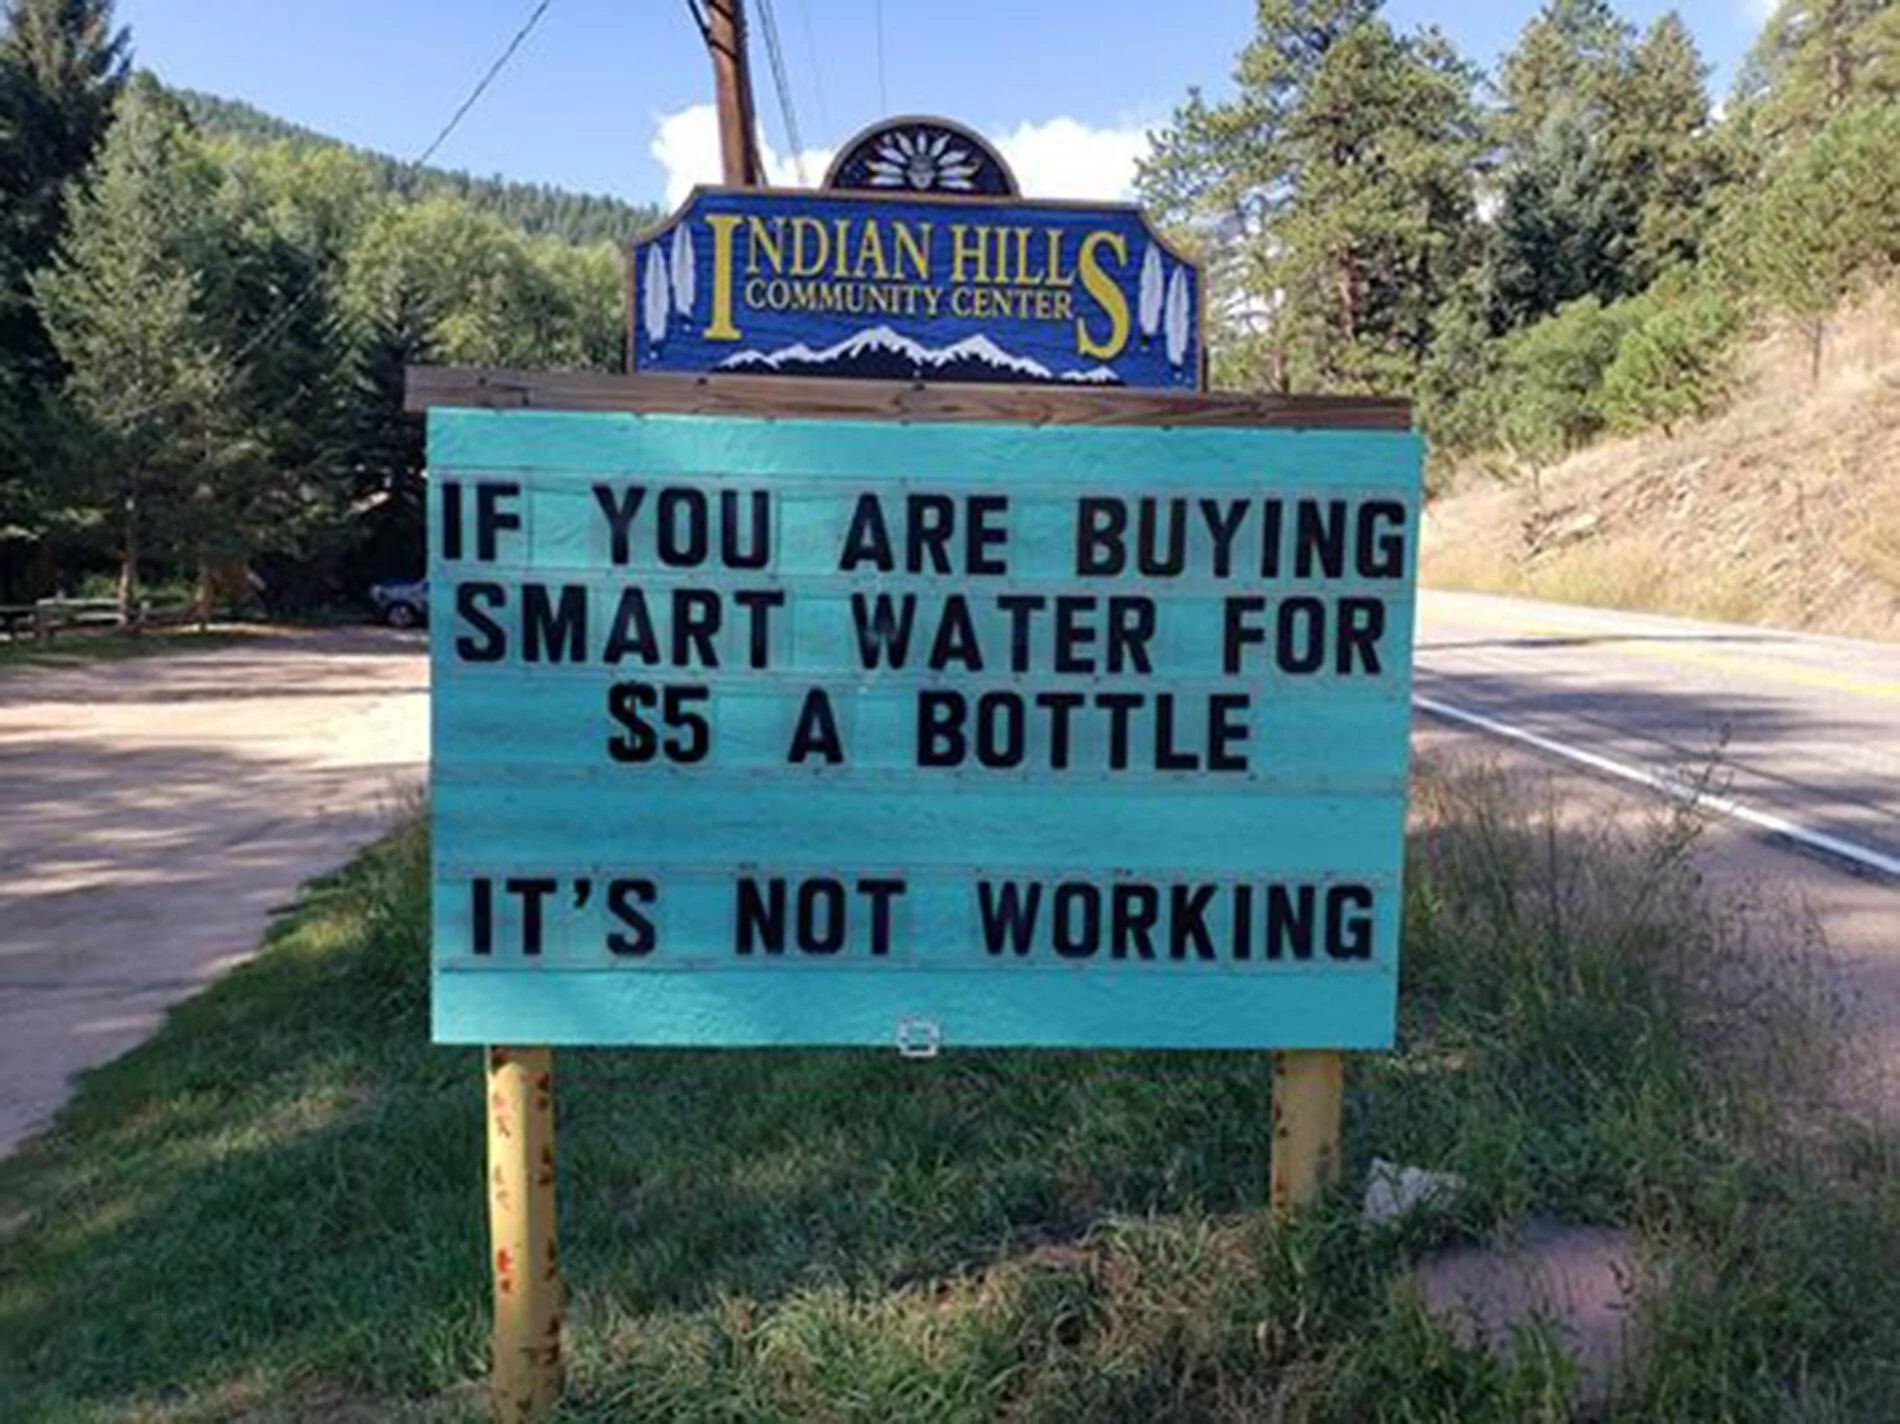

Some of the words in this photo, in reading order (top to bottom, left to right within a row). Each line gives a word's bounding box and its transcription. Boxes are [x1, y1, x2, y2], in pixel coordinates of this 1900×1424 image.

[704, 214, 931, 341] INDIAN
[950, 224, 1129, 360] HILLS
[745, 279, 943, 316] COMMUNITY
[955, 286, 1073, 321] CENTER
[441, 482, 521, 561] IF
[592, 483, 770, 570] YOU
[839, 493, 1009, 576] ARE
[1076, 496, 1406, 579] BUYING
[455, 582, 785, 669] SMART
[851, 592, 1156, 674] WATER
[1222, 595, 1385, 674] FOR
[607, 680, 710, 765] $5
[788, 686, 844, 764] A
[916, 689, 1251, 771] BOTTLE
[470, 877, 657, 958] IT'S
[735, 877, 906, 957] NOT
[977, 880, 1373, 961] WORKING
